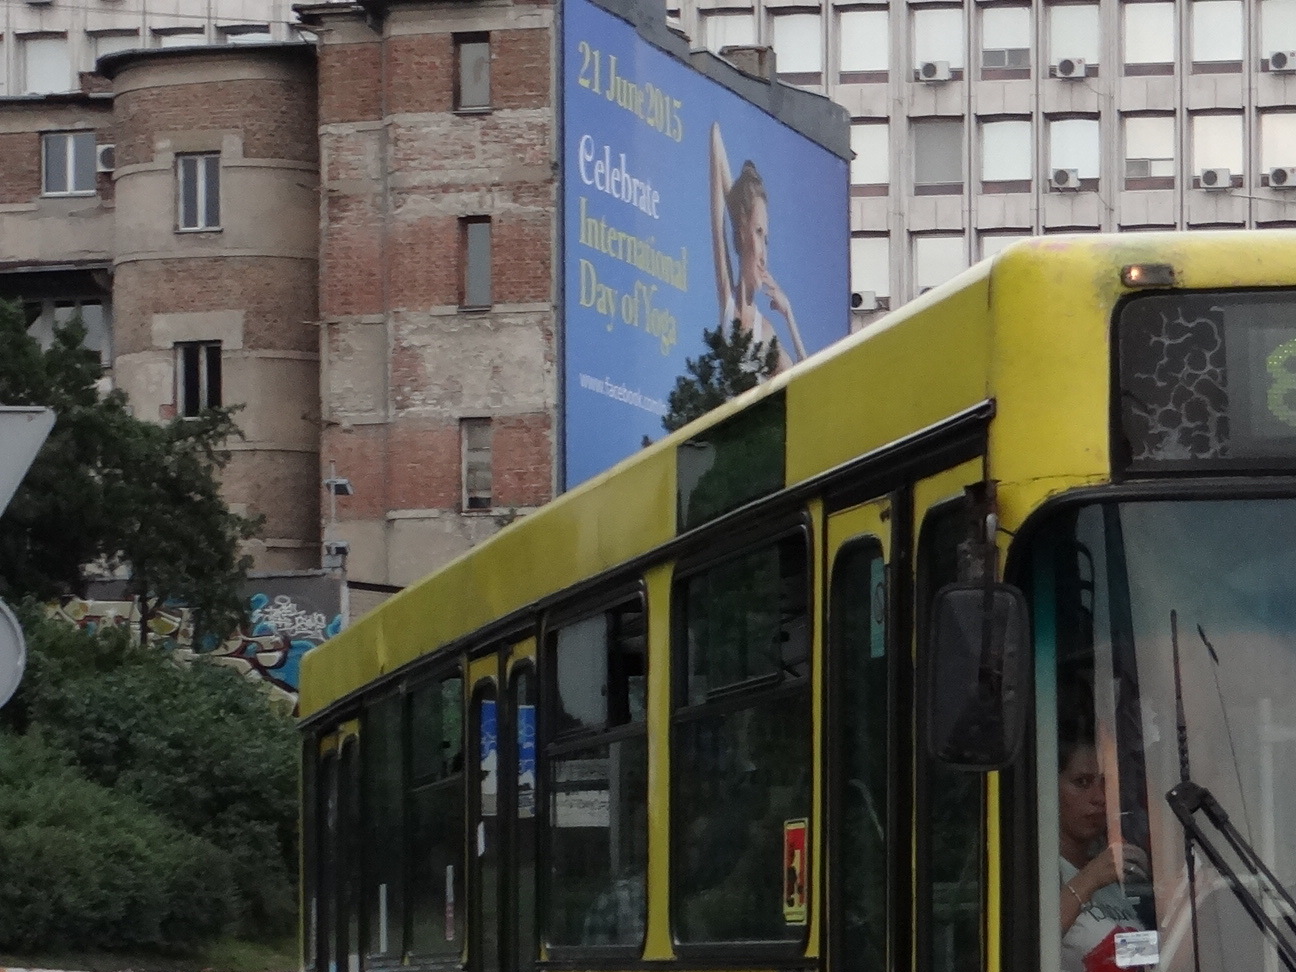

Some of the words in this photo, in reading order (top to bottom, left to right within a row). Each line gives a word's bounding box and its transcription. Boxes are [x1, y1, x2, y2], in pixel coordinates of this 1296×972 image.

[578, 41, 602, 95] 21
[606, 55, 644, 120] June
[645, 81, 682, 143] 2015
[579, 134, 660, 219] Celebrate
[579, 195, 687, 293] International
[579, 258, 617, 332] Day
[621, 279, 644, 327] of
[643, 283, 677, 356] Yoga
